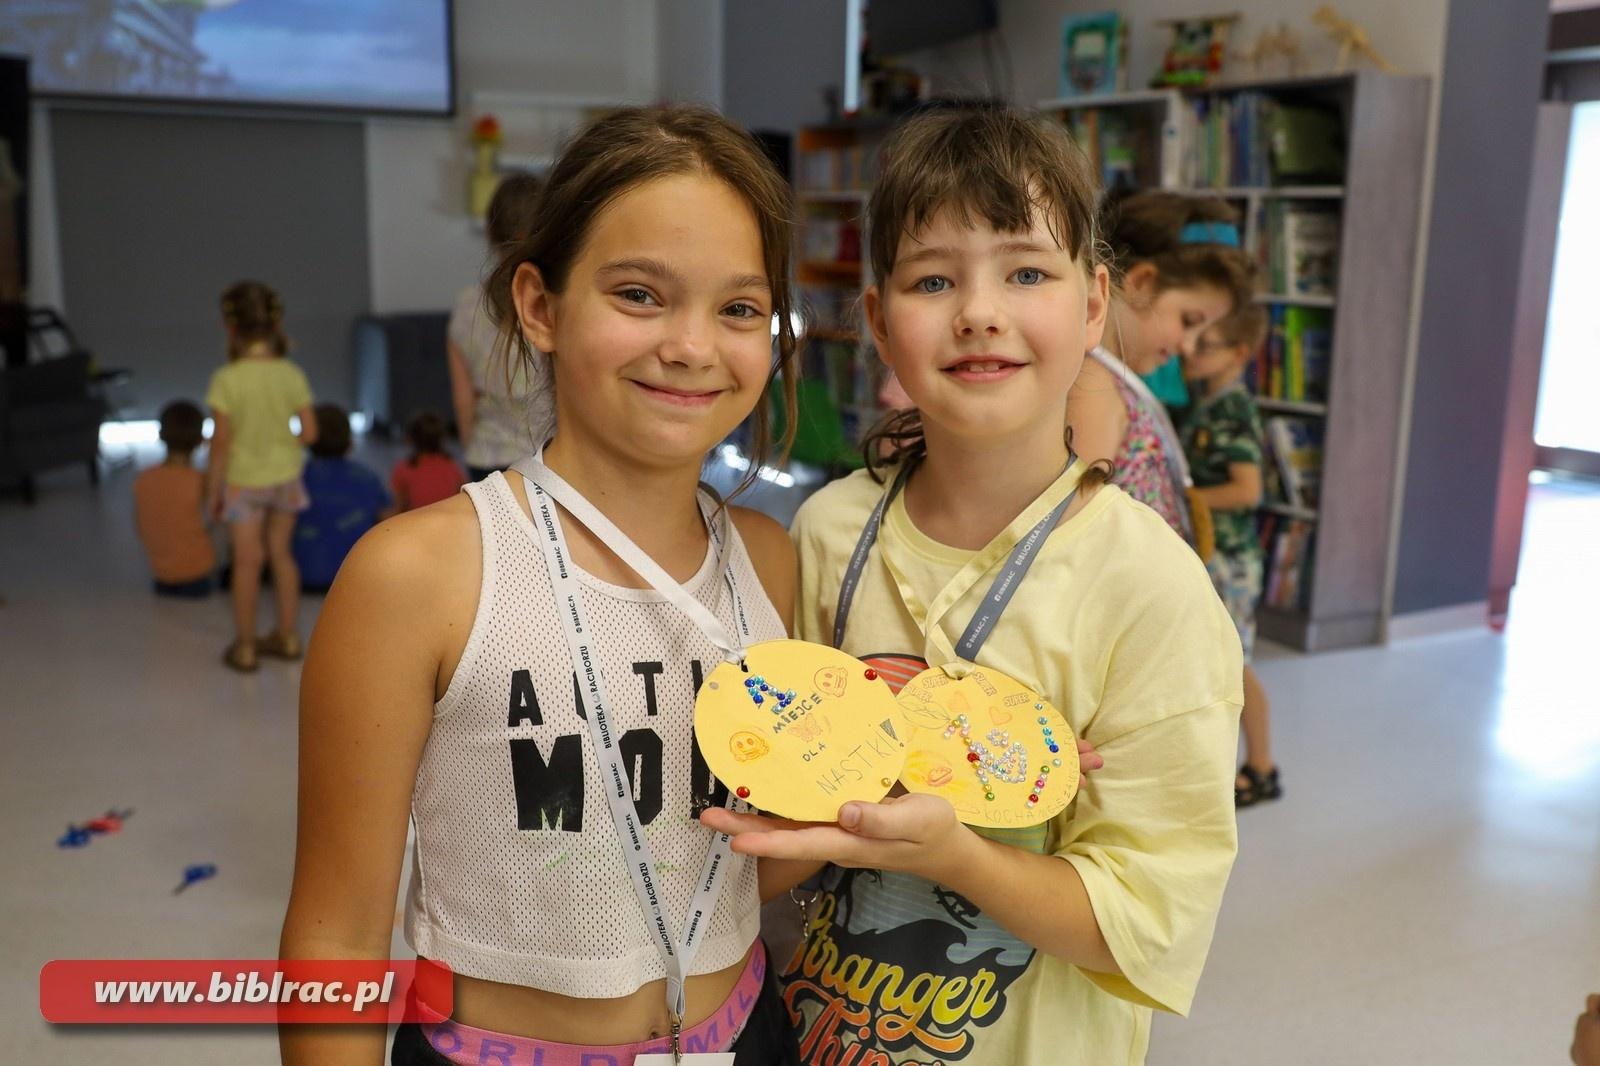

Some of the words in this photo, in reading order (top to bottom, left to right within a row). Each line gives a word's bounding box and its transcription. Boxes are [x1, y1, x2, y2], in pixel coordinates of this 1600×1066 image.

[579, 645, 598, 693] RACIBORZU
[595, 704, 613, 749] BIBLIOTEKA
[802, 742, 827, 762] DLA
[638, 862, 658, 906] RACIBORZU
[656, 916, 674, 956] BIBLIOTEKA
